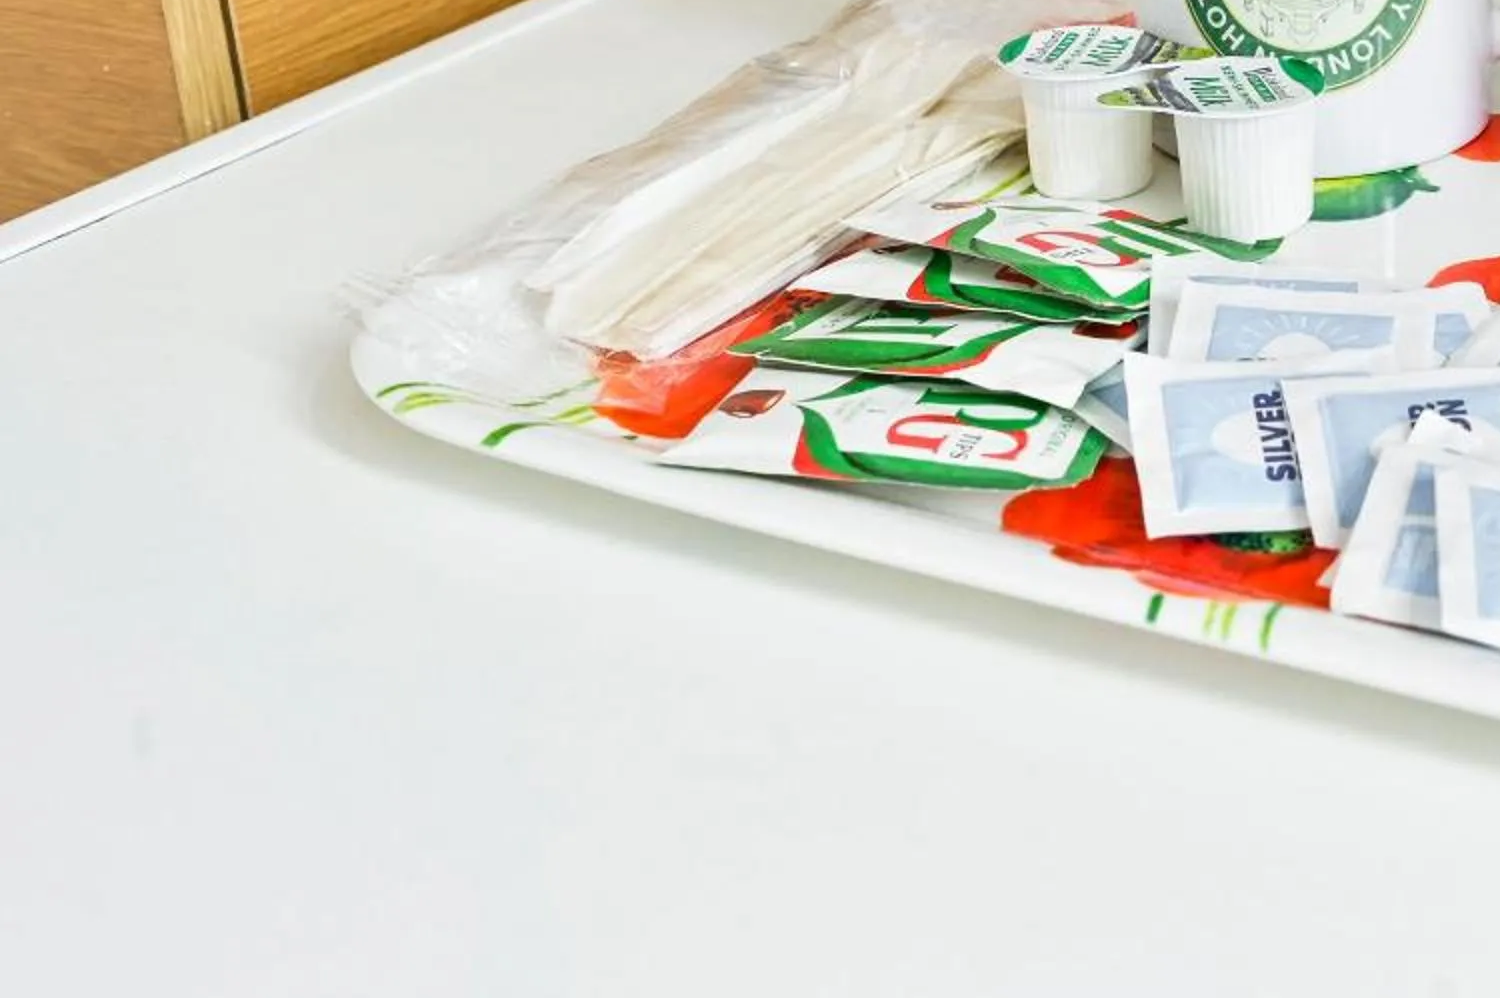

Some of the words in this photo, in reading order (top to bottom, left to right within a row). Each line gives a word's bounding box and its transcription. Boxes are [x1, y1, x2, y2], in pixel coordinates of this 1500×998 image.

[885, 387, 1051, 461] PG
[950, 433, 983, 461] TIPS
[1252, 388, 1297, 482] SILVER
